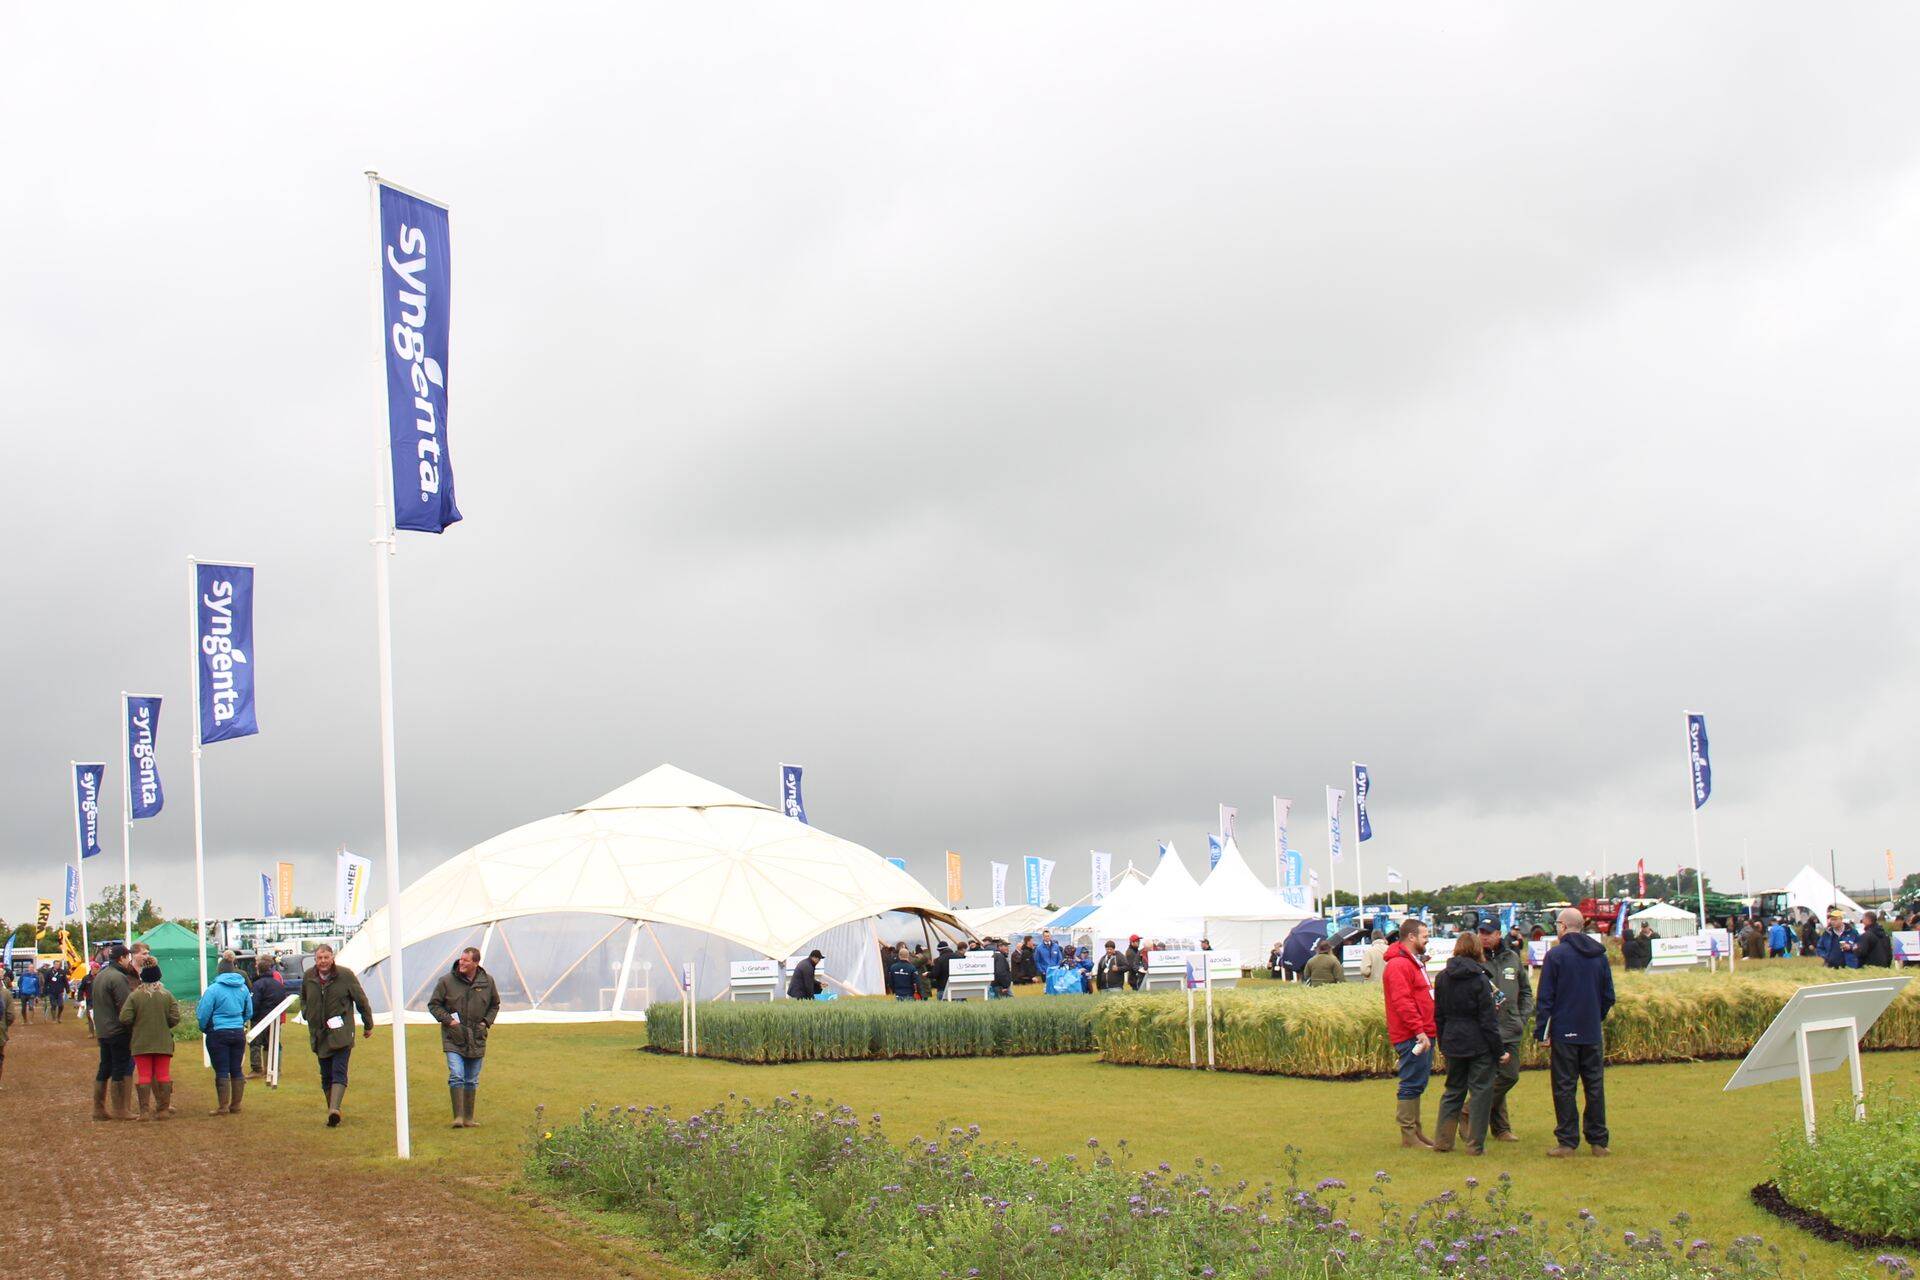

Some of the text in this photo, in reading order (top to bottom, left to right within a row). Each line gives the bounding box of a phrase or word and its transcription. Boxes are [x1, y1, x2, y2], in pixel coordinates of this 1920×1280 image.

[387, 223, 442, 495] syngenta
[202, 580, 240, 721] syngenta
[80, 772, 98, 847] syngenta
[133, 707, 158, 804] syngenta
